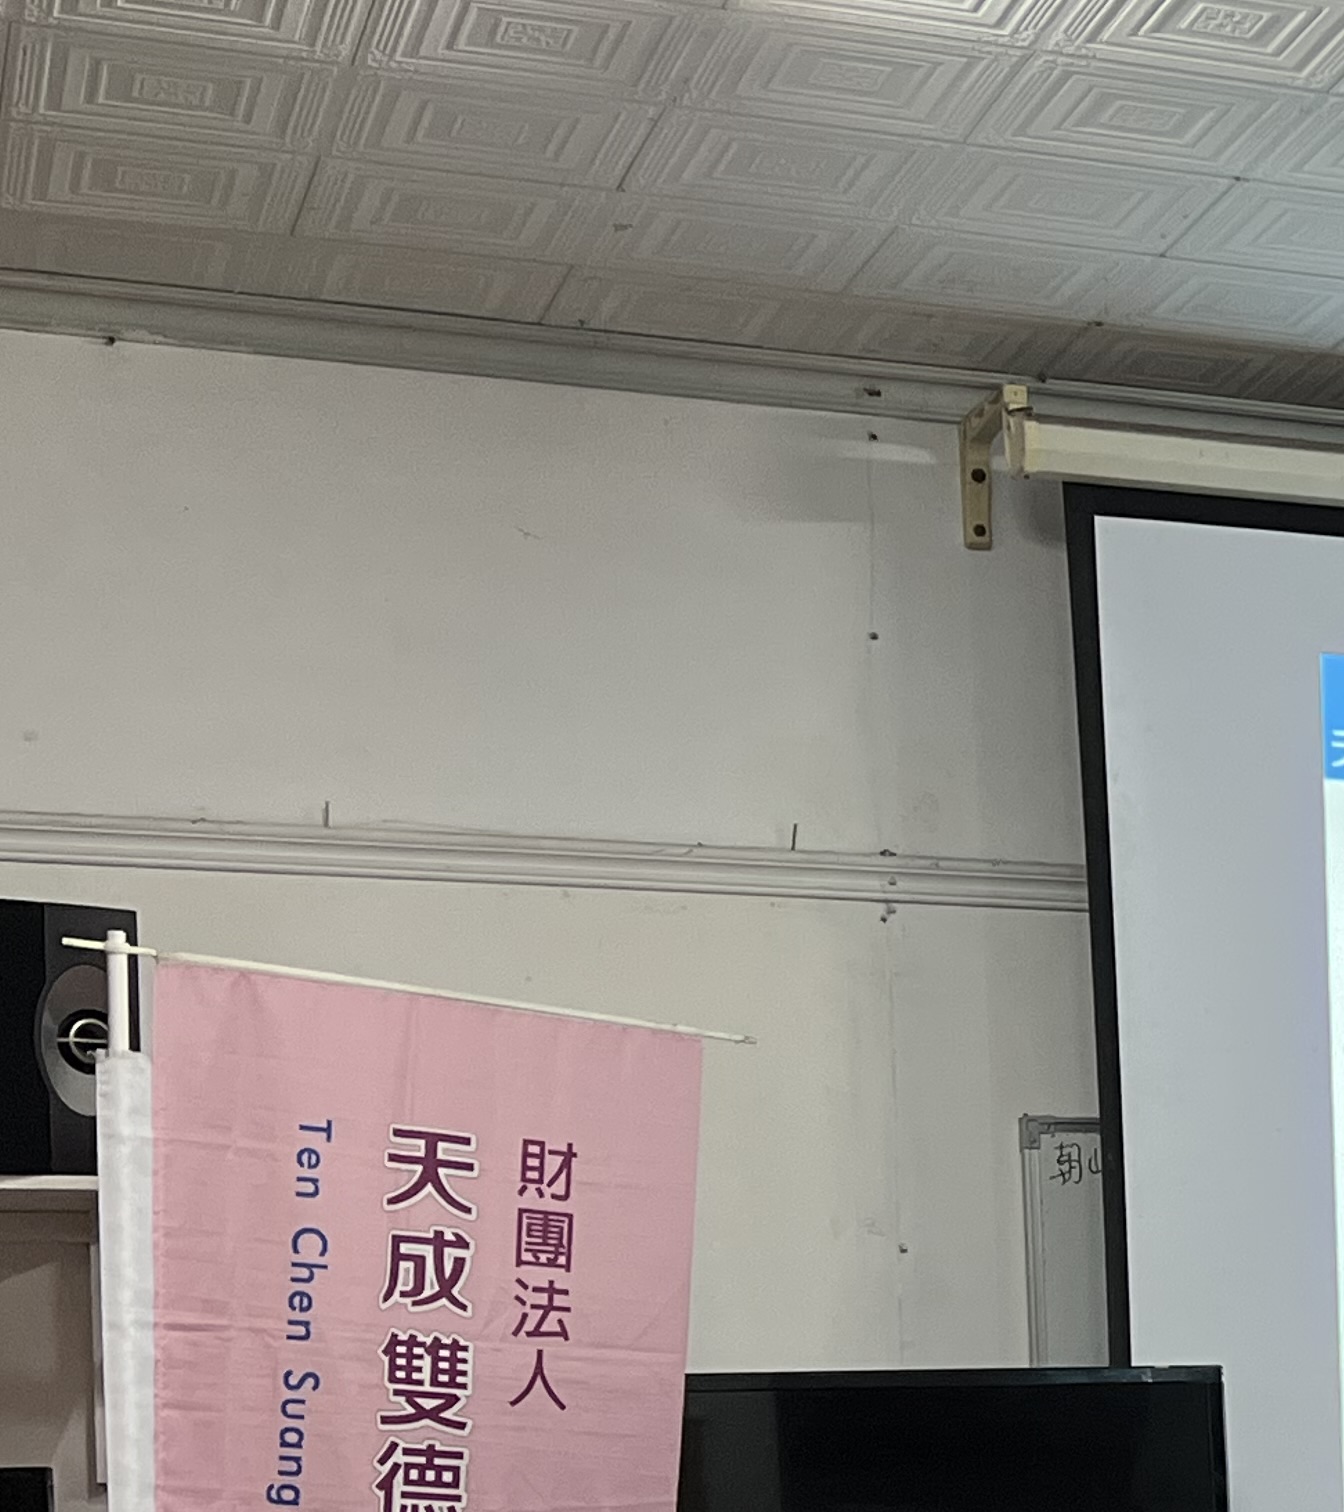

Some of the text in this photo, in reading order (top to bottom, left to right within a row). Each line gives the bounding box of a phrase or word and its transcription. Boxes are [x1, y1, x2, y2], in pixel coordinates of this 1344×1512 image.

[295, 1119, 332, 1199] Ten
[286, 1227, 328, 1342] Chen
[509, 1138, 578, 1411] 財團法人
